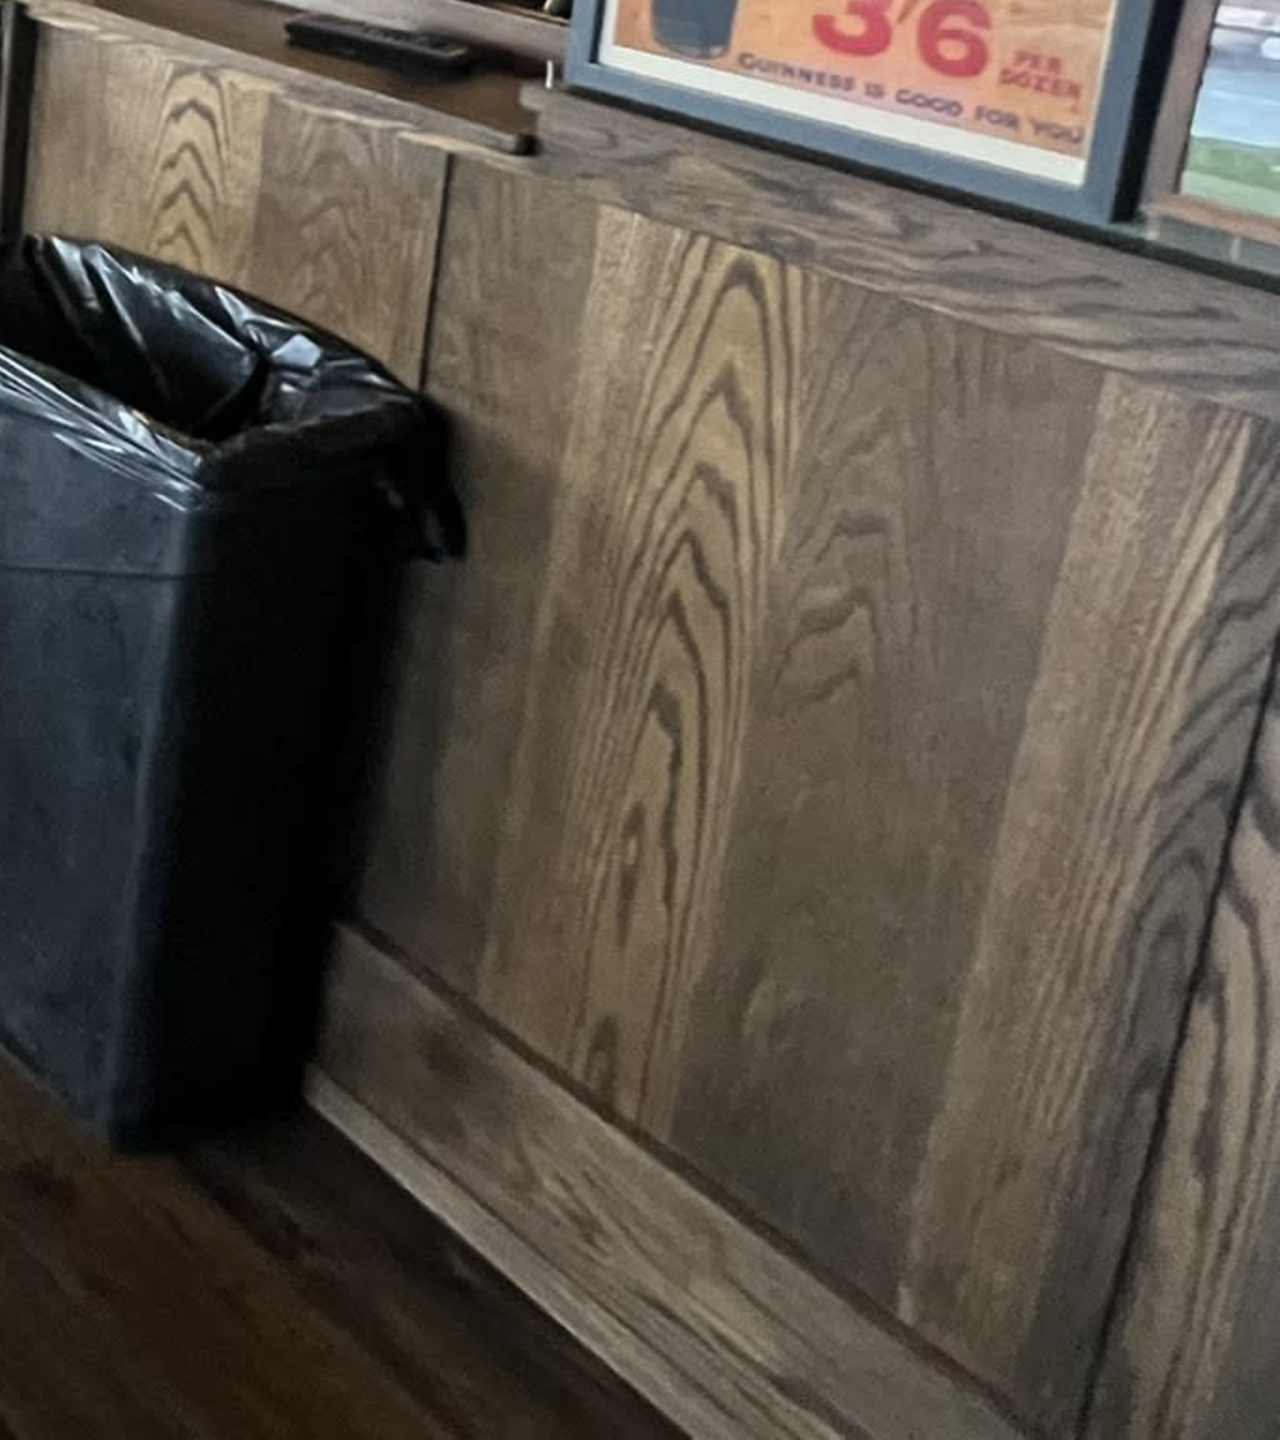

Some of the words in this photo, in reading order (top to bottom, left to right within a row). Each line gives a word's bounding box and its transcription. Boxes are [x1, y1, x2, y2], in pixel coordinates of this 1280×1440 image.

[738, 51, 856, 94] GUINNESS
[864, 81, 886, 101] IS
[895, 88, 965, 119] GOOD
[975, 105, 1022, 131] FOR
[1031, 119, 1087, 146] YOU
